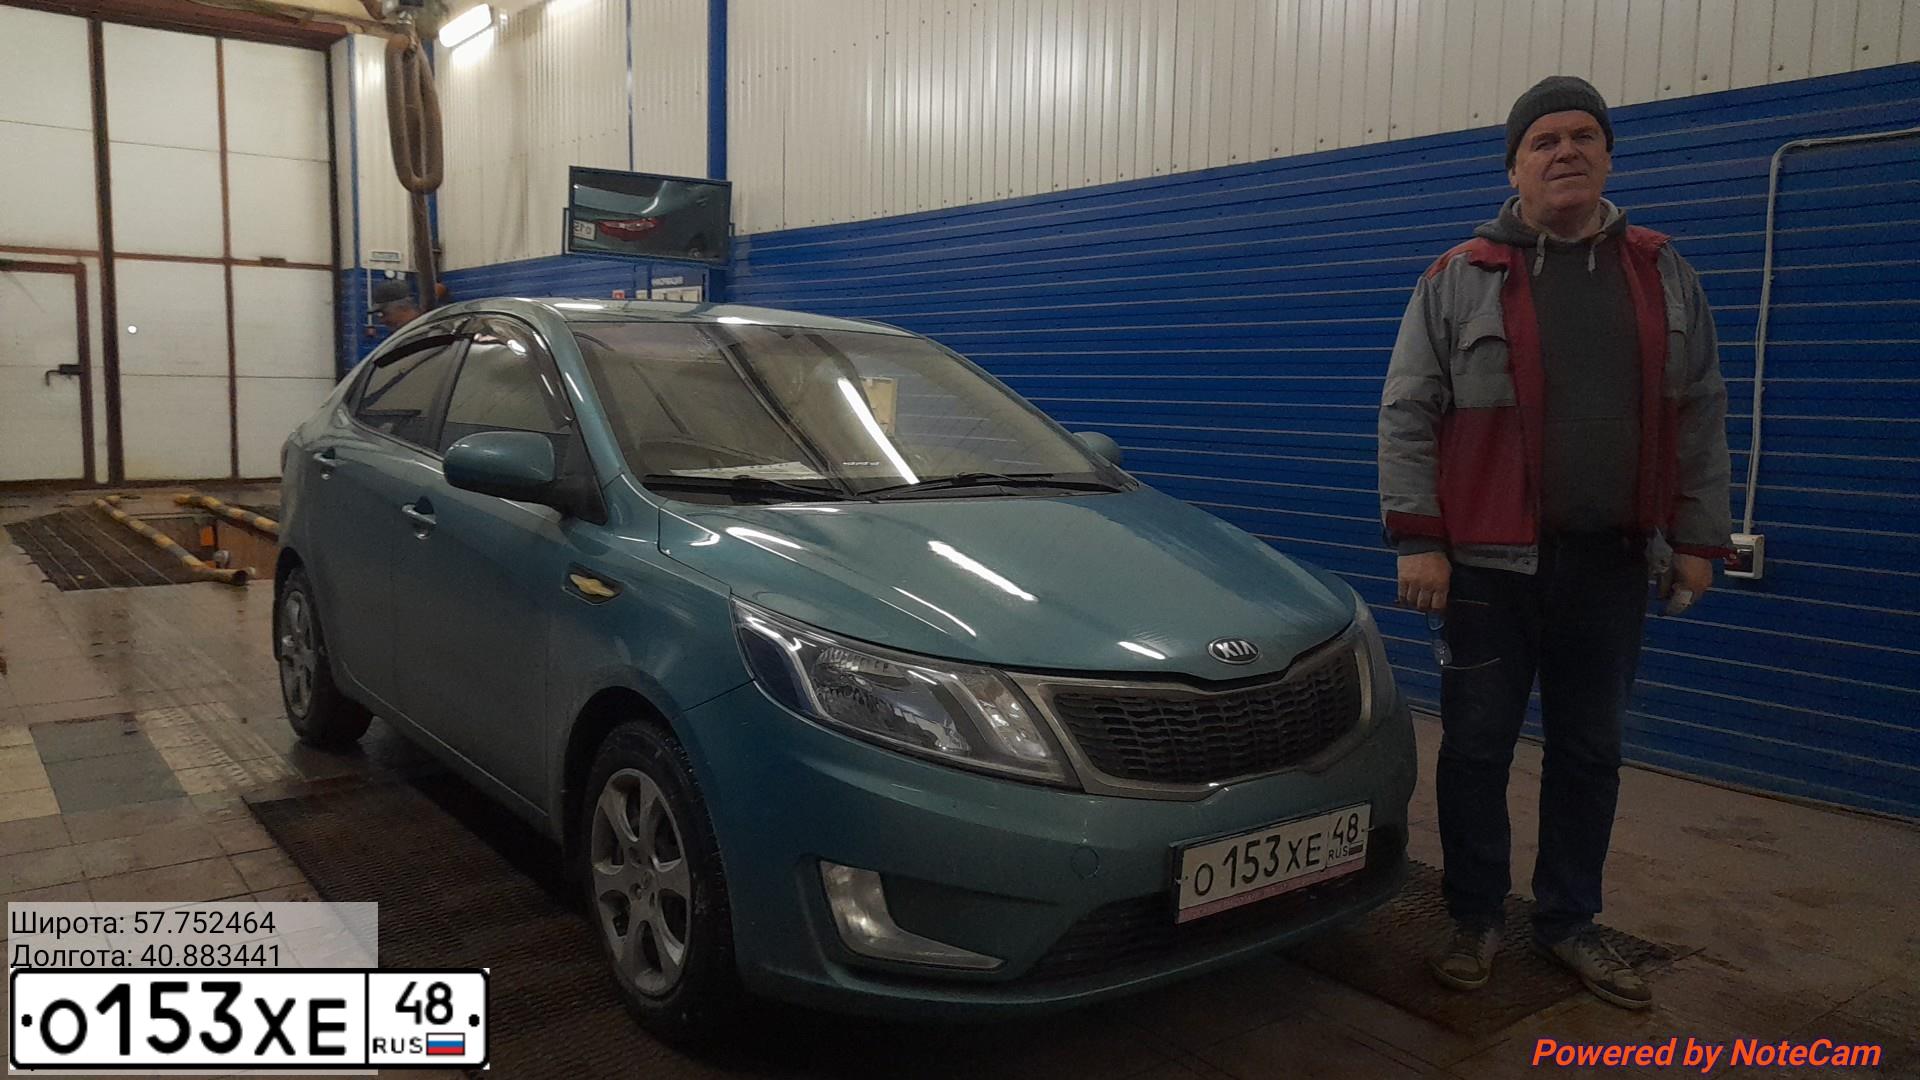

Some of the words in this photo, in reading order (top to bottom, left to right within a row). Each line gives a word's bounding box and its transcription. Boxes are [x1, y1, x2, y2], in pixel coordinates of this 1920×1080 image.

[1215, 640, 1257, 658] KIA
[1332, 812, 1359, 846] 48
[1328, 845, 1349, 860] RUS
